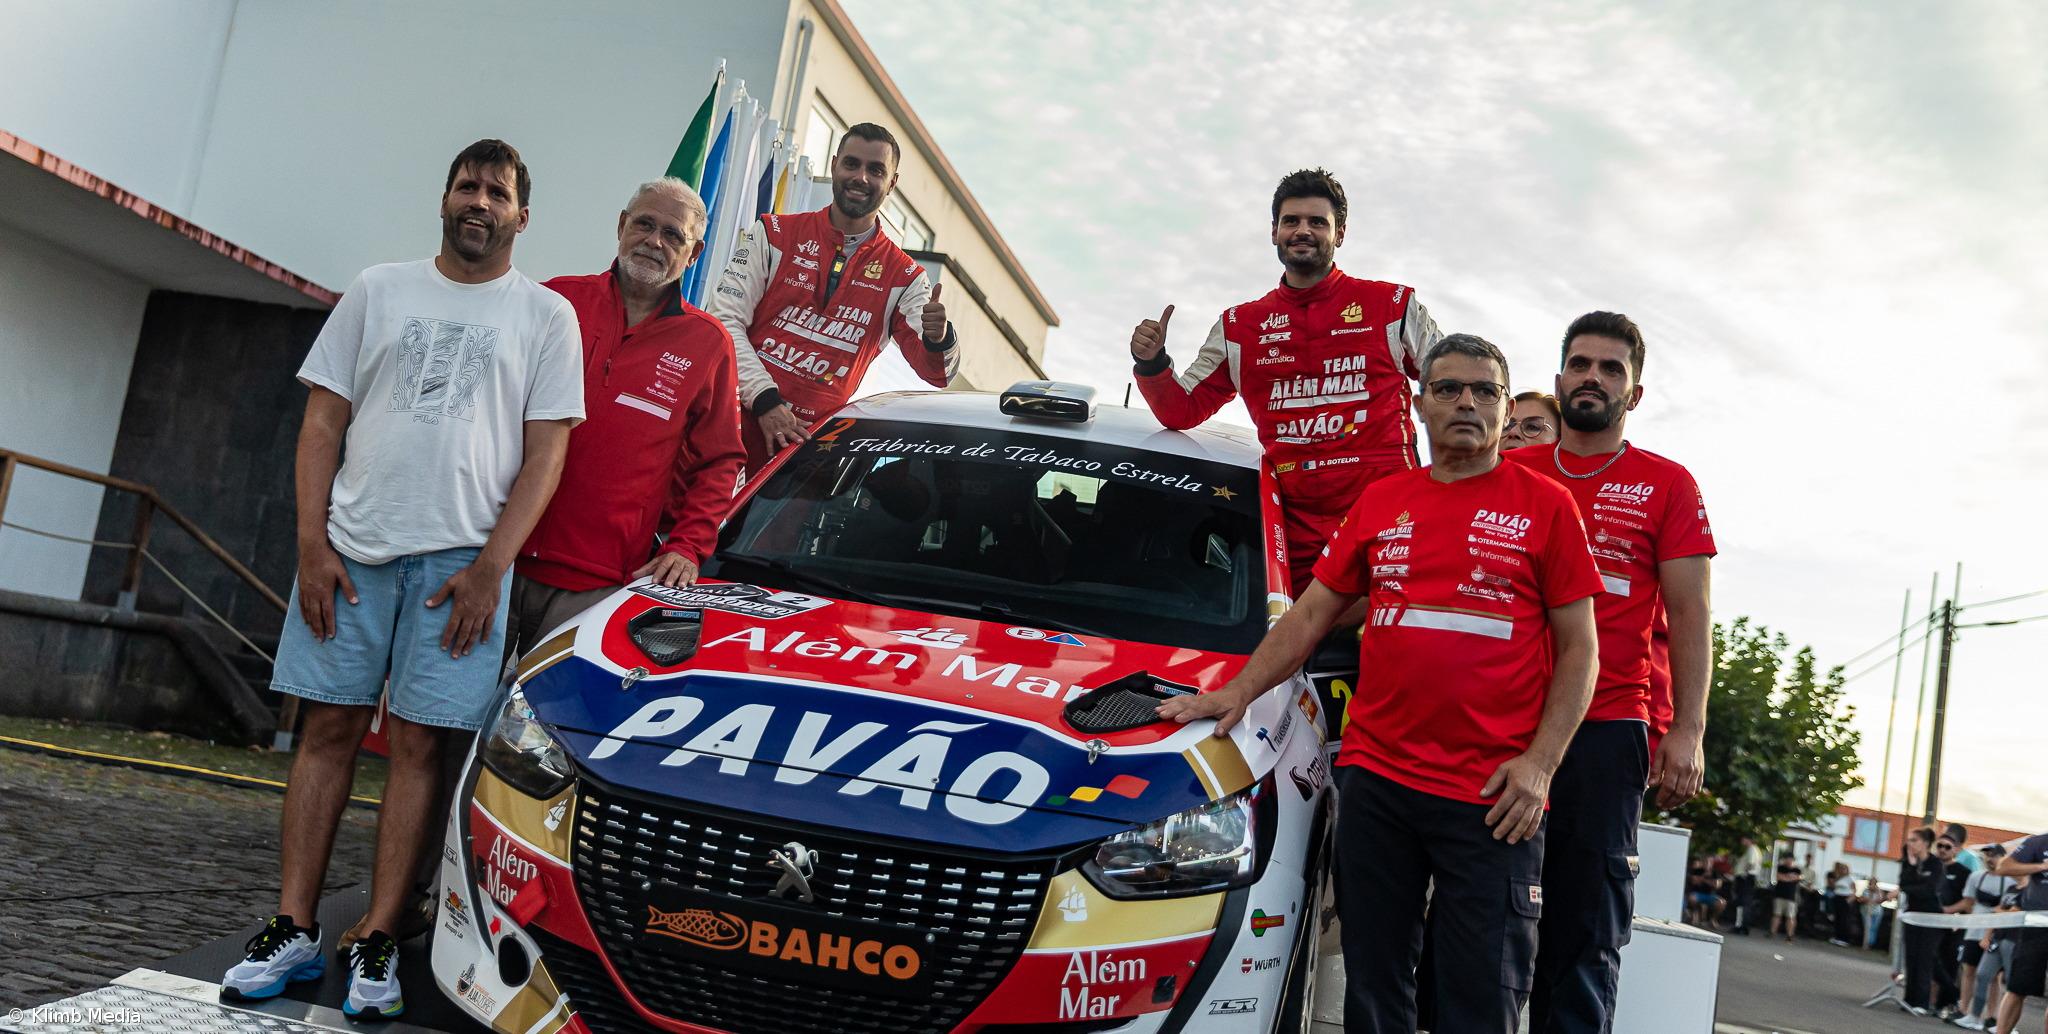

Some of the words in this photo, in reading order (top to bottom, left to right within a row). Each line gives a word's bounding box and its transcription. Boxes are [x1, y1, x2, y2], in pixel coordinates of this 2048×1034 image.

[778, 305, 827, 333] ALÉM
[822, 320, 866, 344] MAR
[835, 305, 873, 325] TEAM
[762, 337, 830, 375] PAVÃO
[1323, 355, 1366, 374] TEAM
[1270, 374, 1318, 400] ALÉM
[1321, 373, 1367, 394] MAR
[413, 413, 439, 425] FILA
[817, 418, 857, 441] 2
[1276, 411, 1344, 437] PAVÃO
[848, 437, 955, 458] Fábrica
[962, 442, 997, 458] de
[1004, 446, 1101, 472] Tabaco
[1110, 462, 1203, 492] Estrela
[1327, 457, 1359, 466] BOTELHO
[1600, 482, 1654, 496] PAVÃO
[1474, 509, 1531, 531] PAVÃO
[1602, 505, 1647, 518] OTERMAQUINAS
[1377, 541, 1409, 560] Ajm
[1477, 538, 1526, 552] OTERMAQUINAS
[783, 596, 810, 604] 2
[702, 626, 919, 669] Além
[941, 655, 1092, 702] Mar
[588, 696, 1050, 825] PAVÃO
[489, 834, 538, 881] Além
[486, 863, 518, 906] Mar
[749, 922, 920, 980] BAHCO
[1061, 950, 1147, 985] Além
[1254, 956, 1281, 971] WÜRTH
[1058, 986, 1121, 1019] Mar
